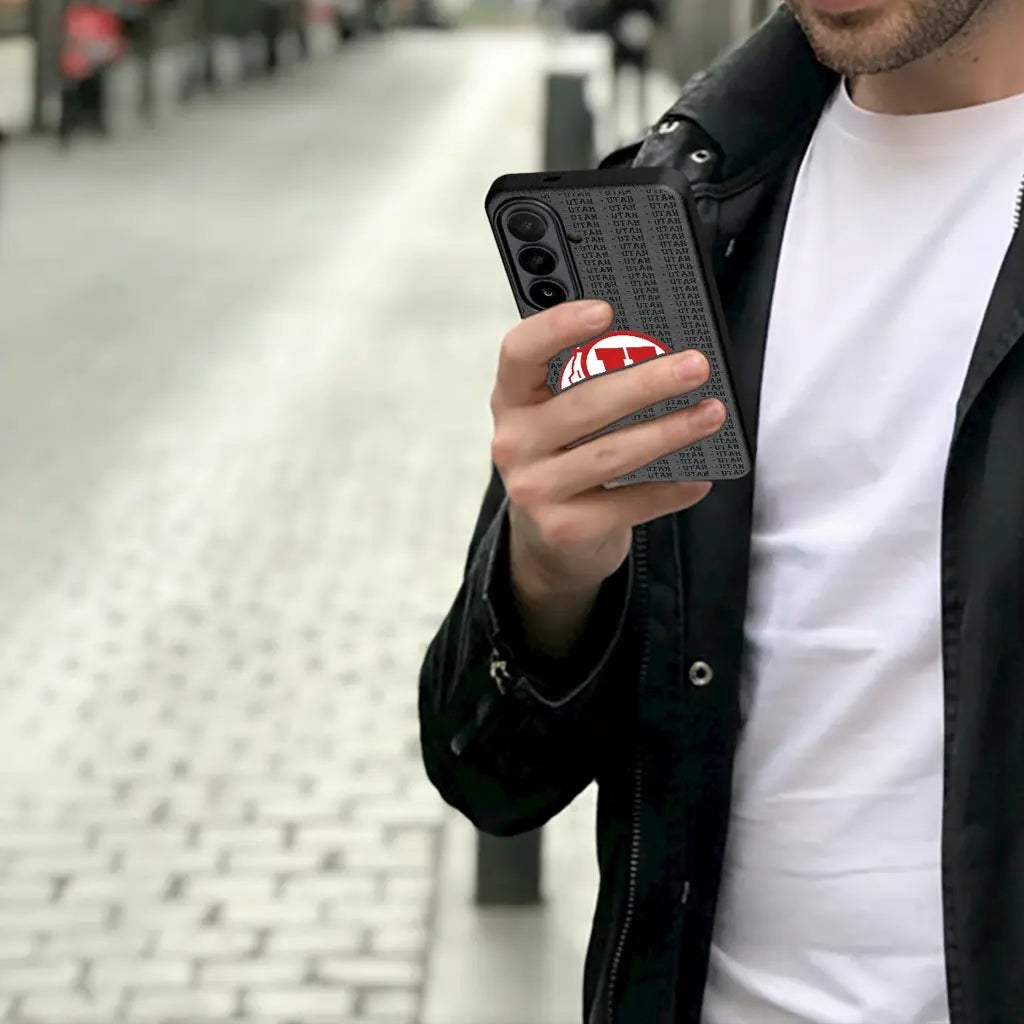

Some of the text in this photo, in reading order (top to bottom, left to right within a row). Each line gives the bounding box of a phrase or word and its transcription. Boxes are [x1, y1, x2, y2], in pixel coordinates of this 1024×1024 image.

[566, 198, 593, 206] UTAH
[606, 196, 634, 204] UTAH
[654, 217, 681, 225] UTAH
